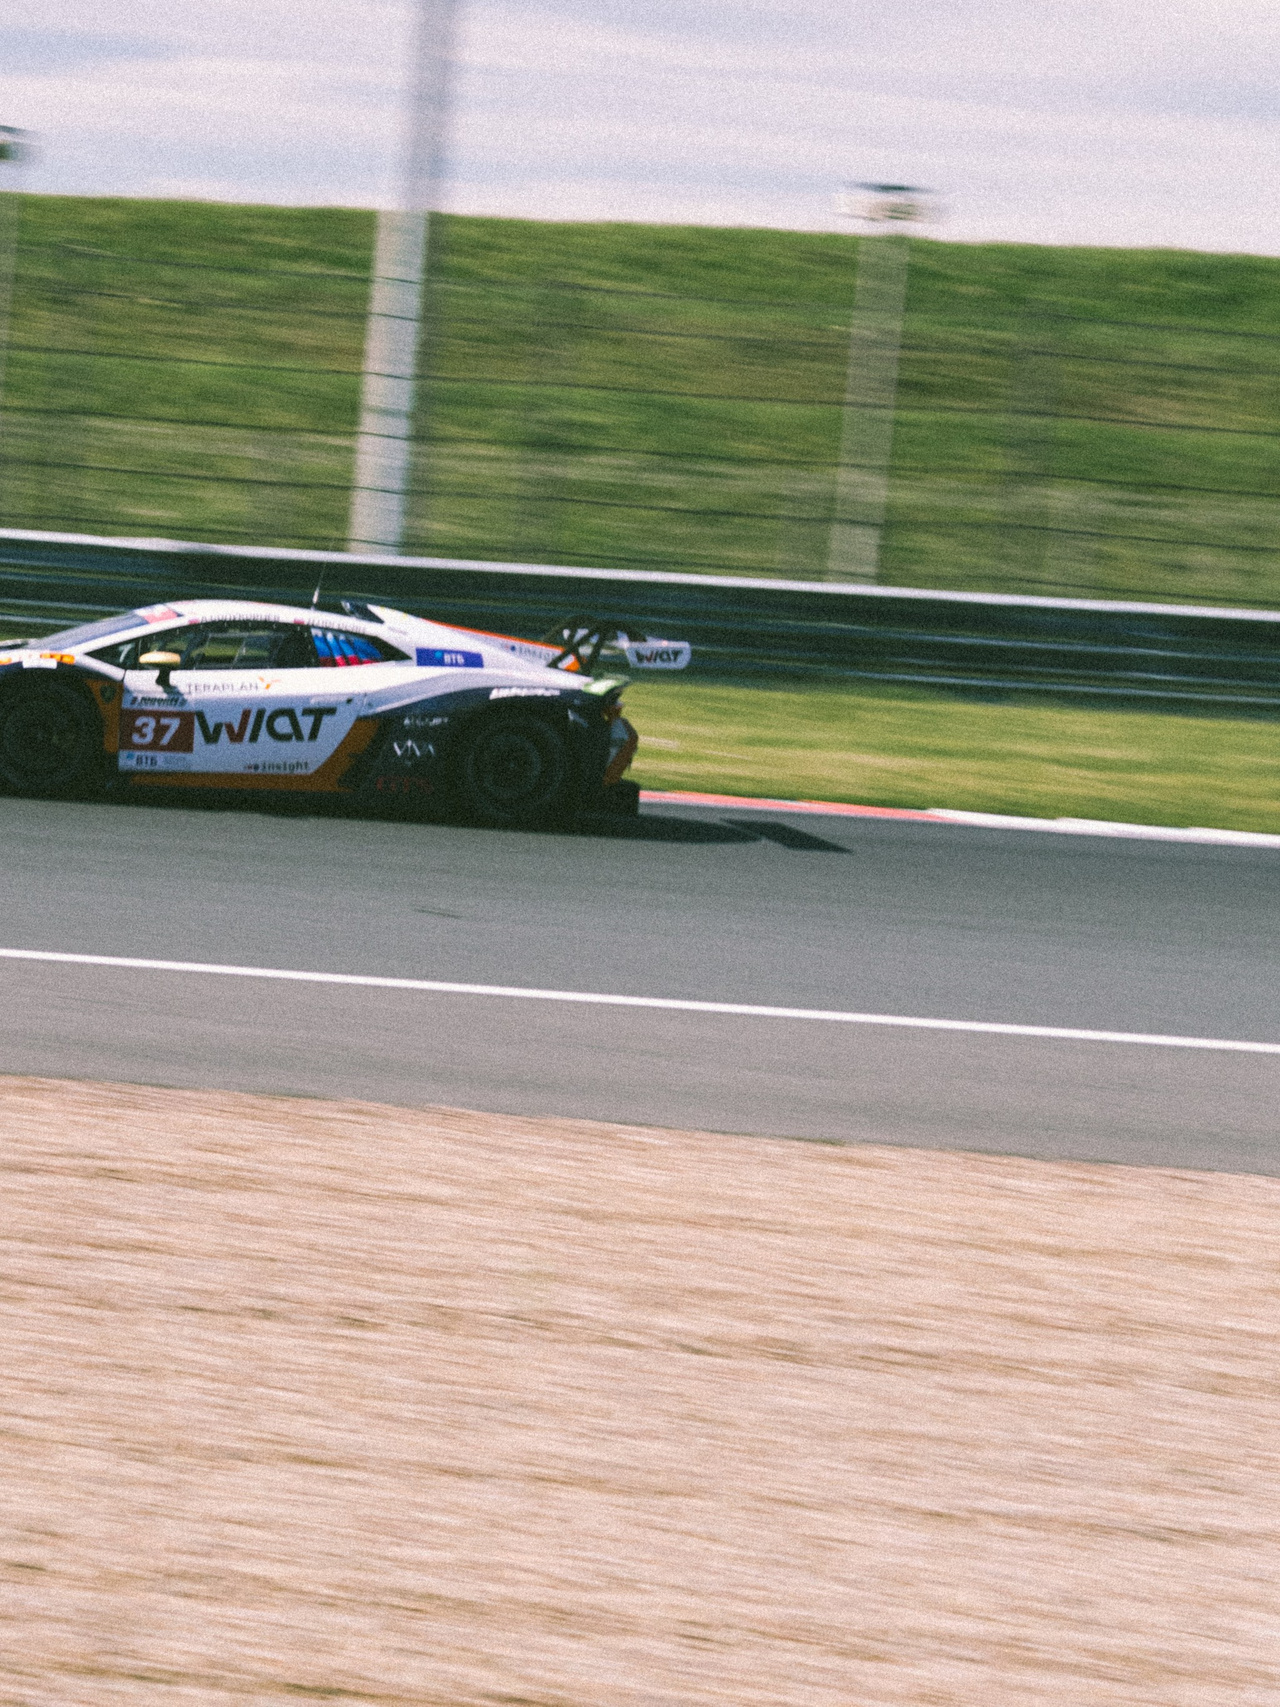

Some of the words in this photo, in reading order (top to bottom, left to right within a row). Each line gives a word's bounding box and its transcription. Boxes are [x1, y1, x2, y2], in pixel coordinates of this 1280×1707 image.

[186, 682, 259, 694] TERAPLAN
[131, 716, 182, 746] 37
[194, 706, 338, 744] WIAT
